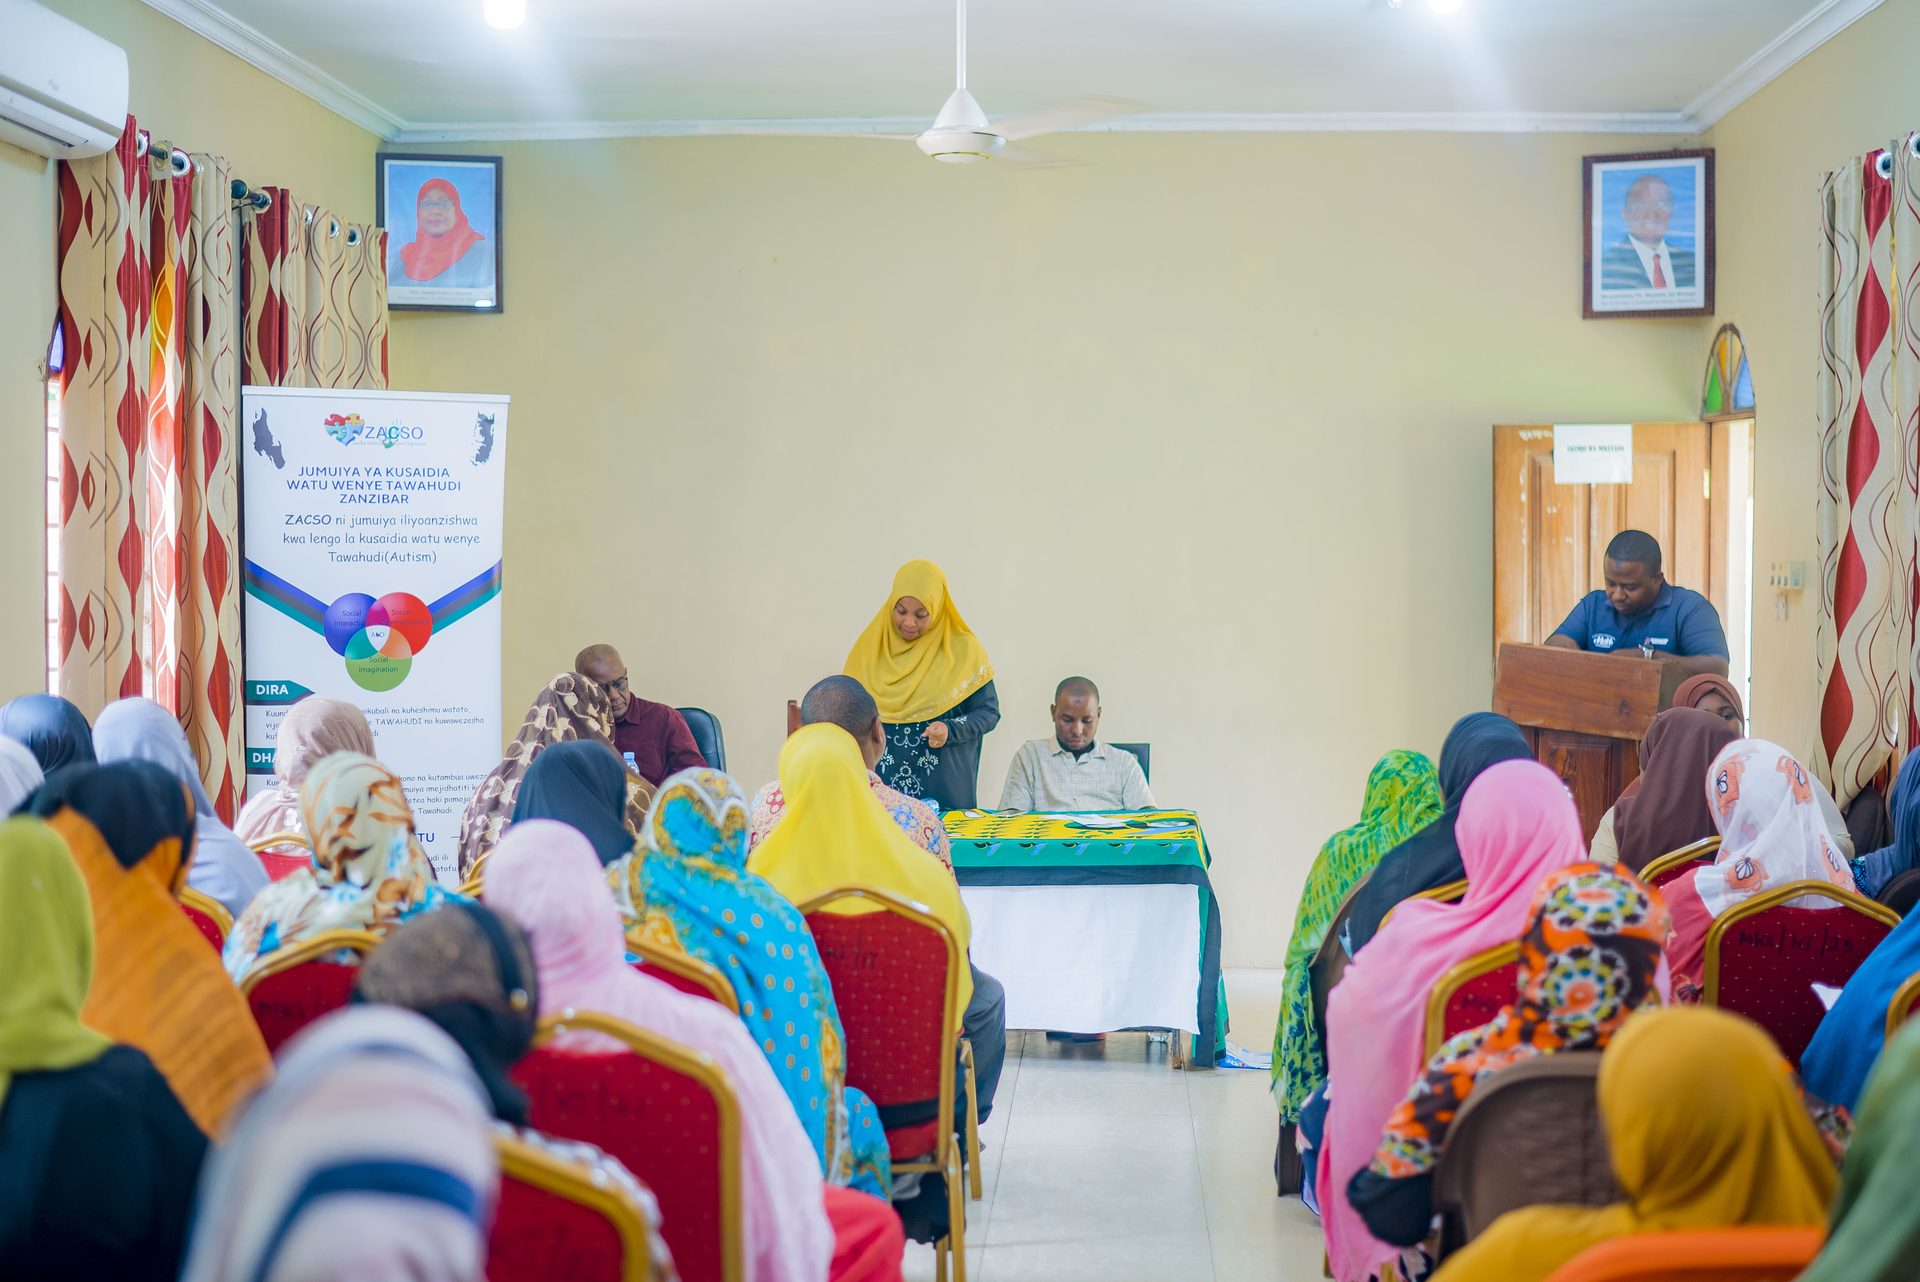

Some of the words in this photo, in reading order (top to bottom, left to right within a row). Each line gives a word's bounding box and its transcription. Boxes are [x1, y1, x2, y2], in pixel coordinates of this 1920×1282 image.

[365, 426, 423, 440] ZACSO
[298, 466, 360, 477] JUMUIYA
[364, 467, 382, 477] YA
[386, 468, 450, 478] KUSAIDIA
[286, 480, 328, 490] WATU
[332, 480, 383, 490] WENYE
[386, 481, 461, 491] TAWAHUDI
[339, 494, 409, 504] ZANZIBAR
[285, 514, 332, 525] ZACSO
[336, 516, 346, 525] ni
[350, 516, 396, 528] jumuiya
[400, 514, 478, 528] iliyoanzishwa
[283, 533, 306, 544] kwa
[310, 533, 341, 546] lengo
[345, 533, 355, 544] la
[359, 533, 408, 544] kusaidia
[412, 534, 440, 544] watu
[444, 536, 480, 546] wenye
[328, 551, 437, 564] Tawahudi(Autism)
[256, 684, 288, 695] DIRA
[361, 707, 389, 715] okubali
[416, 833, 435, 842] TU
